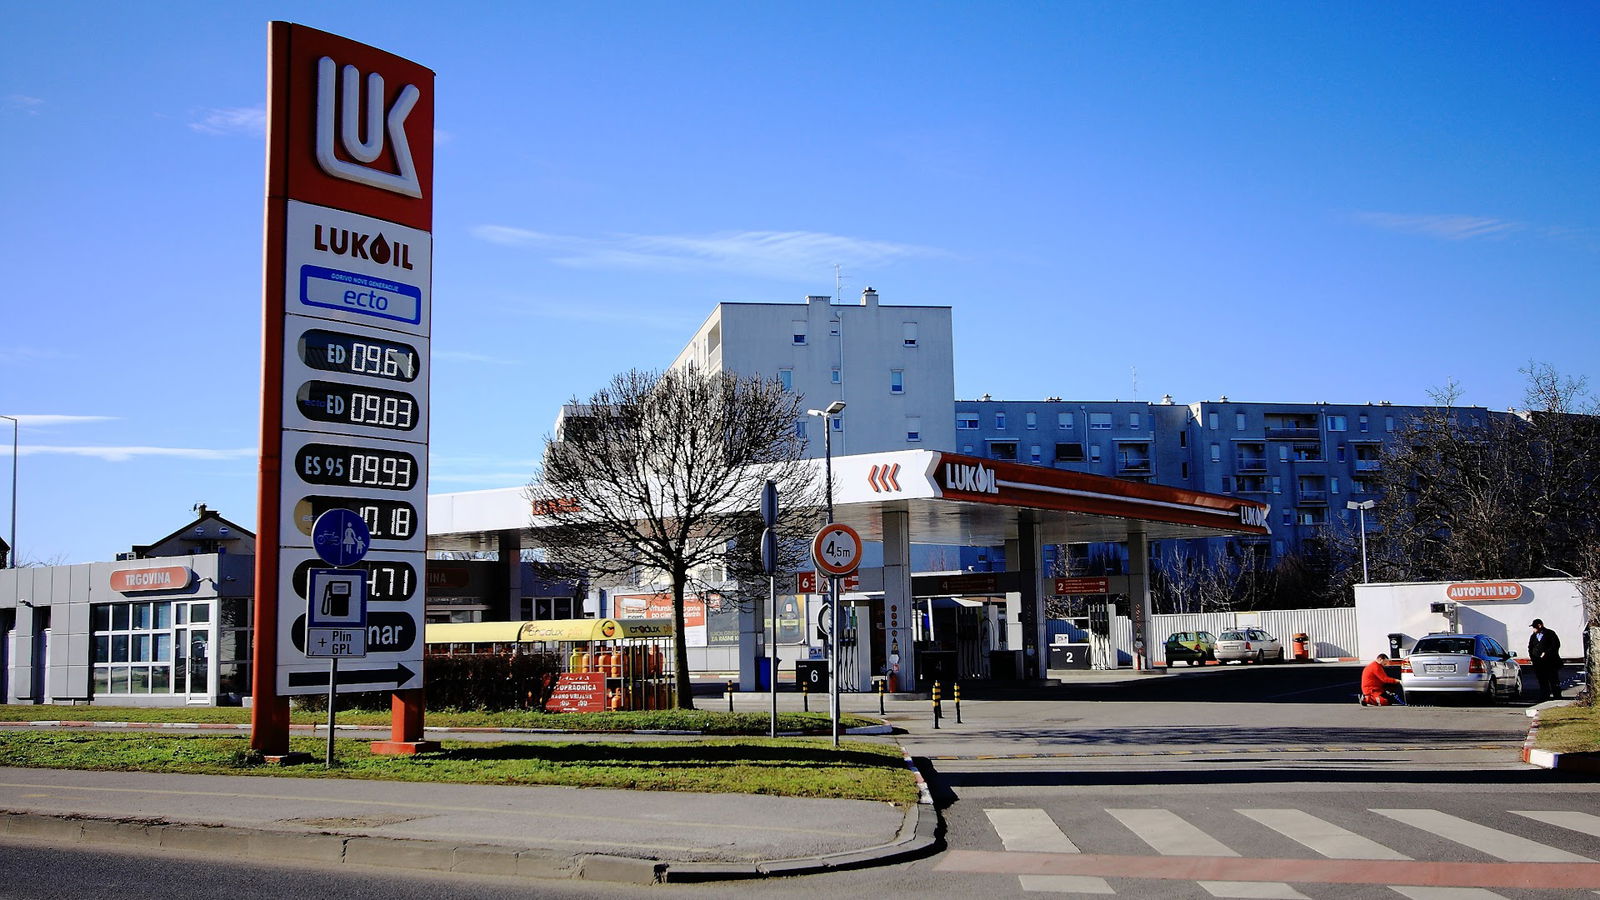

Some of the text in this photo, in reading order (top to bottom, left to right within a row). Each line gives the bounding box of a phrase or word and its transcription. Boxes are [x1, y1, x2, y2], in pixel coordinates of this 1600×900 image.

[314, 224, 414, 271] LUKOIL
[331, 273, 400, 292] GORIVO NOVE GENERACIJE
[344, 290, 389, 311] ecto
[327, 343, 413, 379] ED 09.61
[326, 395, 345, 415] ED
[350, 393, 413, 428] 09.83
[305, 454, 412, 487] ES 95 09.93
[946, 462, 999, 494] LUKOIL
[825, 539, 851, 559] 4,5m
[125, 572, 170, 586] TRGOVINA
[802, 577, 809, 589] 6
[1058, 582, 1064, 591] 2
[1450, 585, 1517, 597] AUTOPLIN LPG
[332, 631, 352, 643] Plin
[367, 625, 403, 646] nar
[629, 624, 661, 634] crodux
[332, 643, 353, 655] GPL
[1066, 652, 1073, 663] 2
[810, 669, 819, 683] 6
